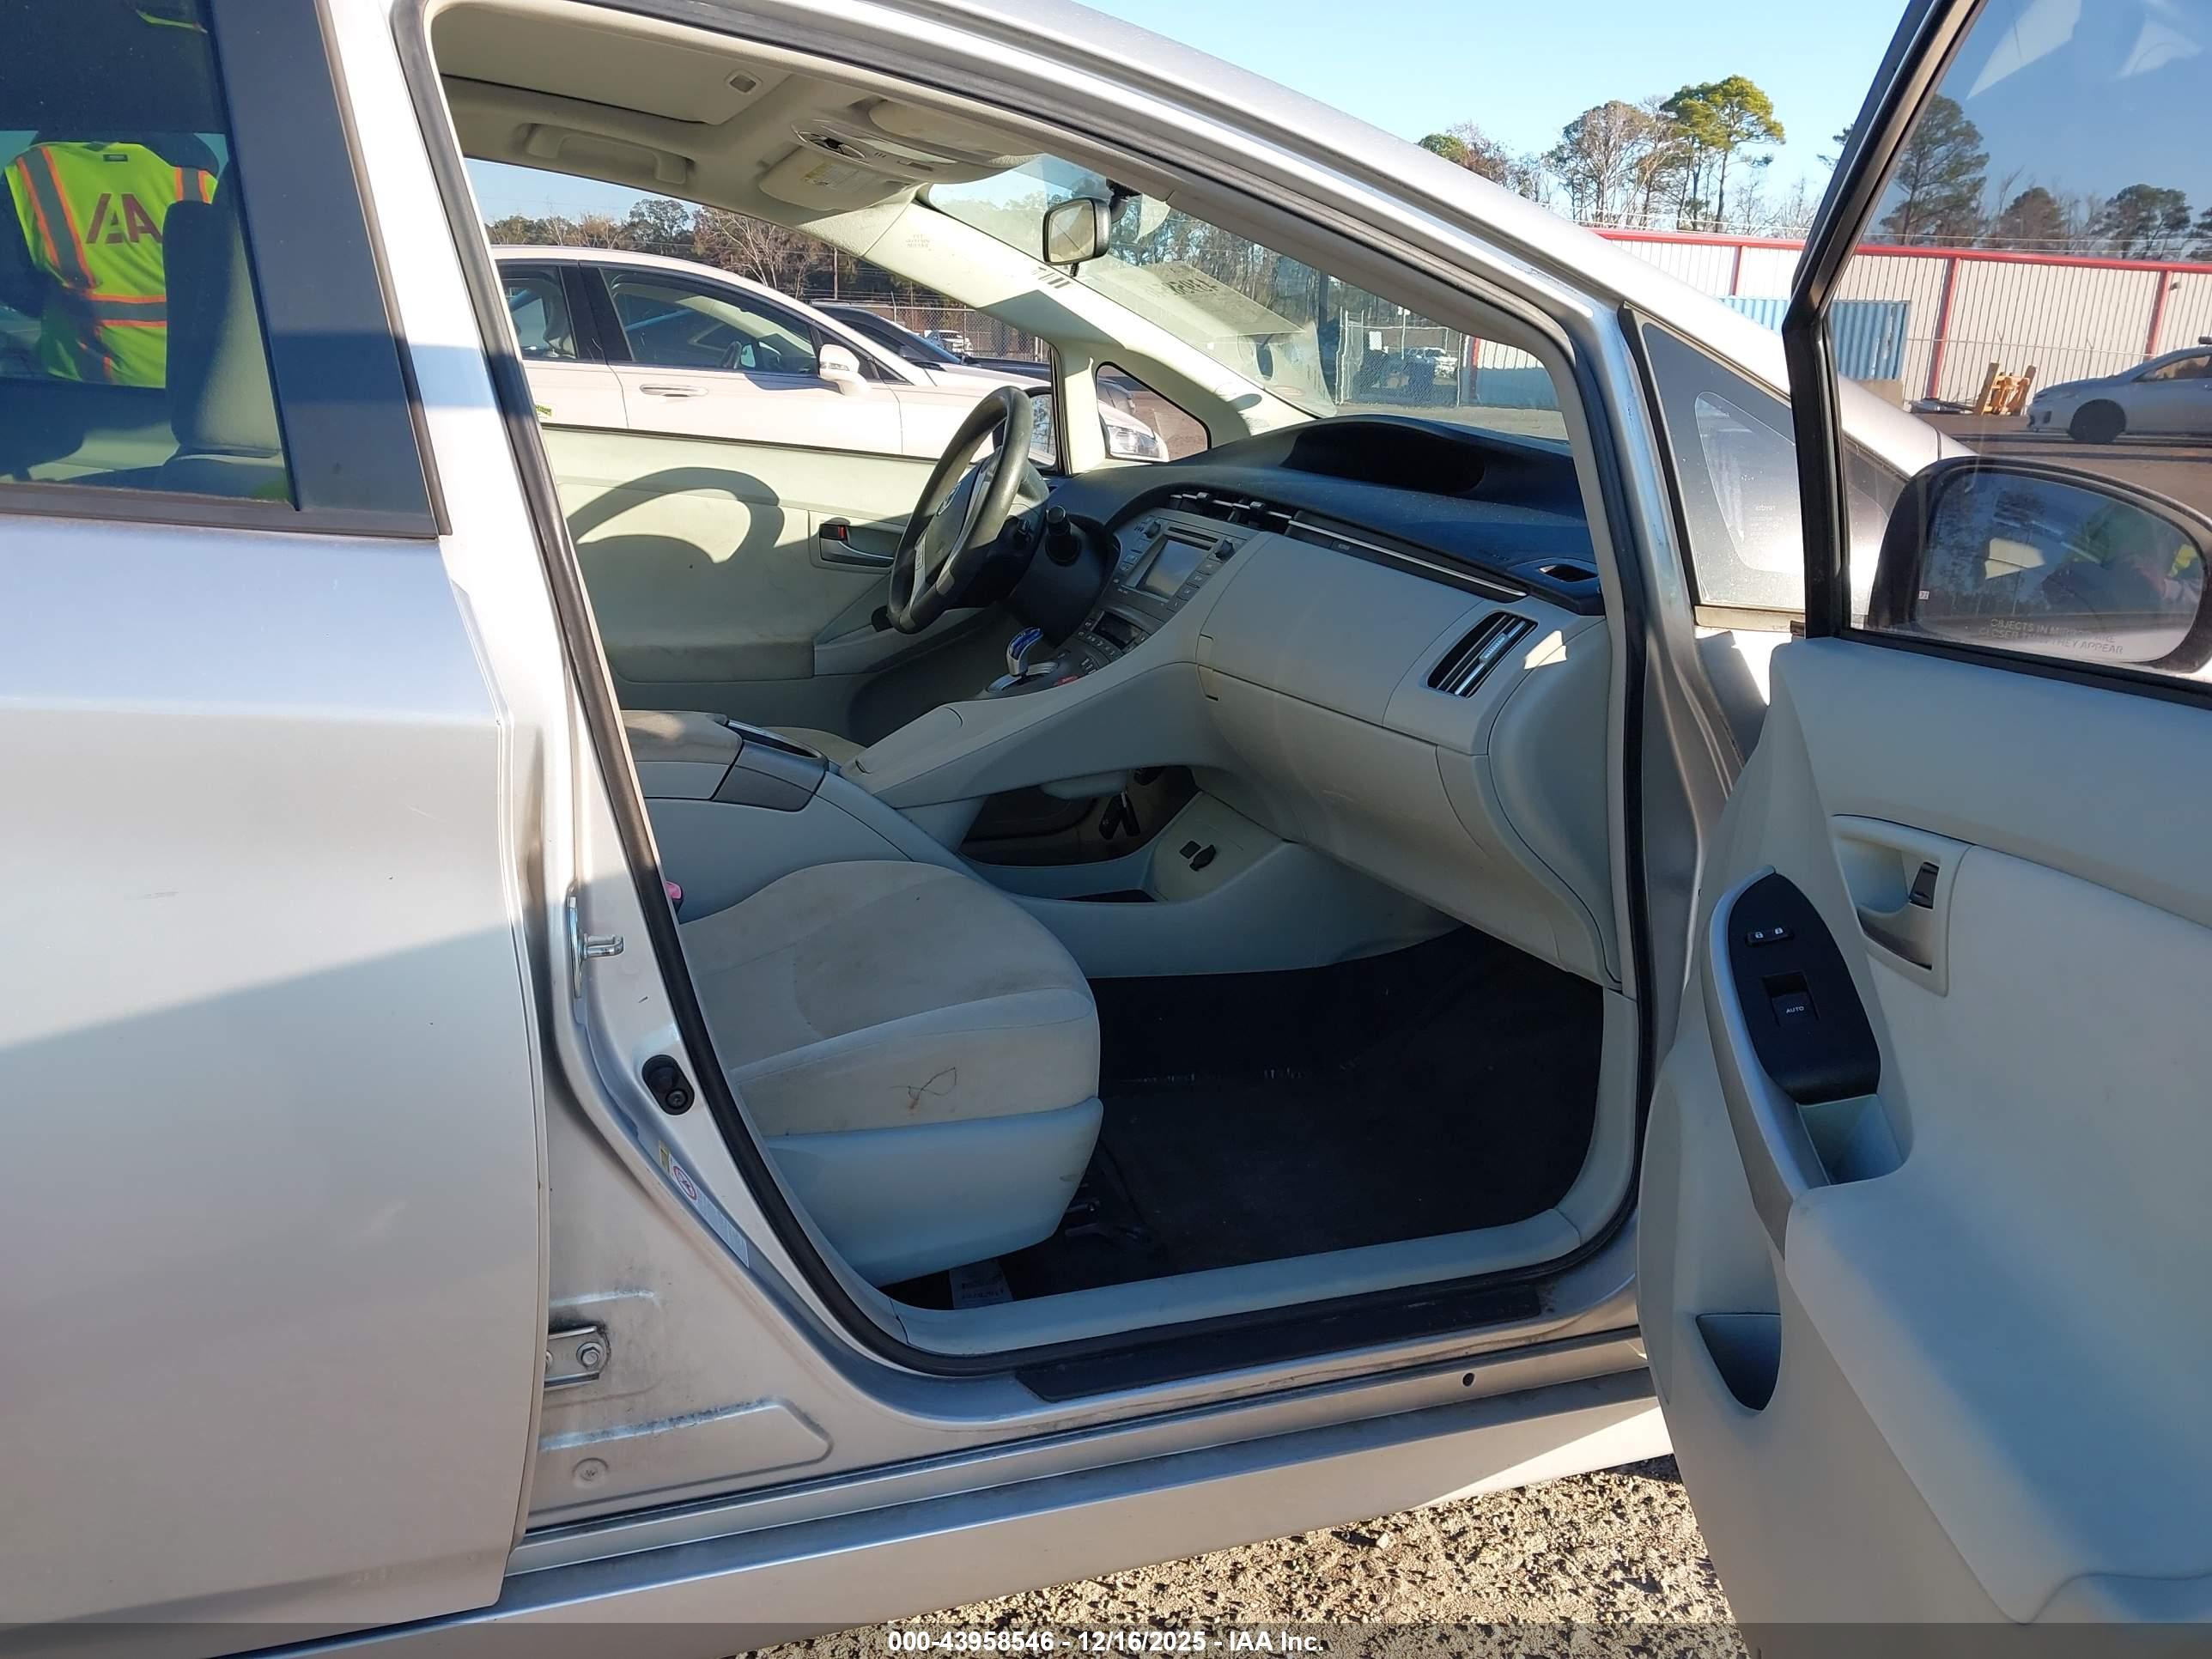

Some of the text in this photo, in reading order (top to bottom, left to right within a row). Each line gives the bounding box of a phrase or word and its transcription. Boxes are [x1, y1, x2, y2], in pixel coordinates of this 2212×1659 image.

[1990, 618, 2034, 633] OBJECTS
[2036, 624, 2048, 635] IN
[1978, 626, 2019, 640] CLOSER
[2081, 641, 2124, 654] APPEAR
[1786, 1006, 1804, 1014] AUTO
